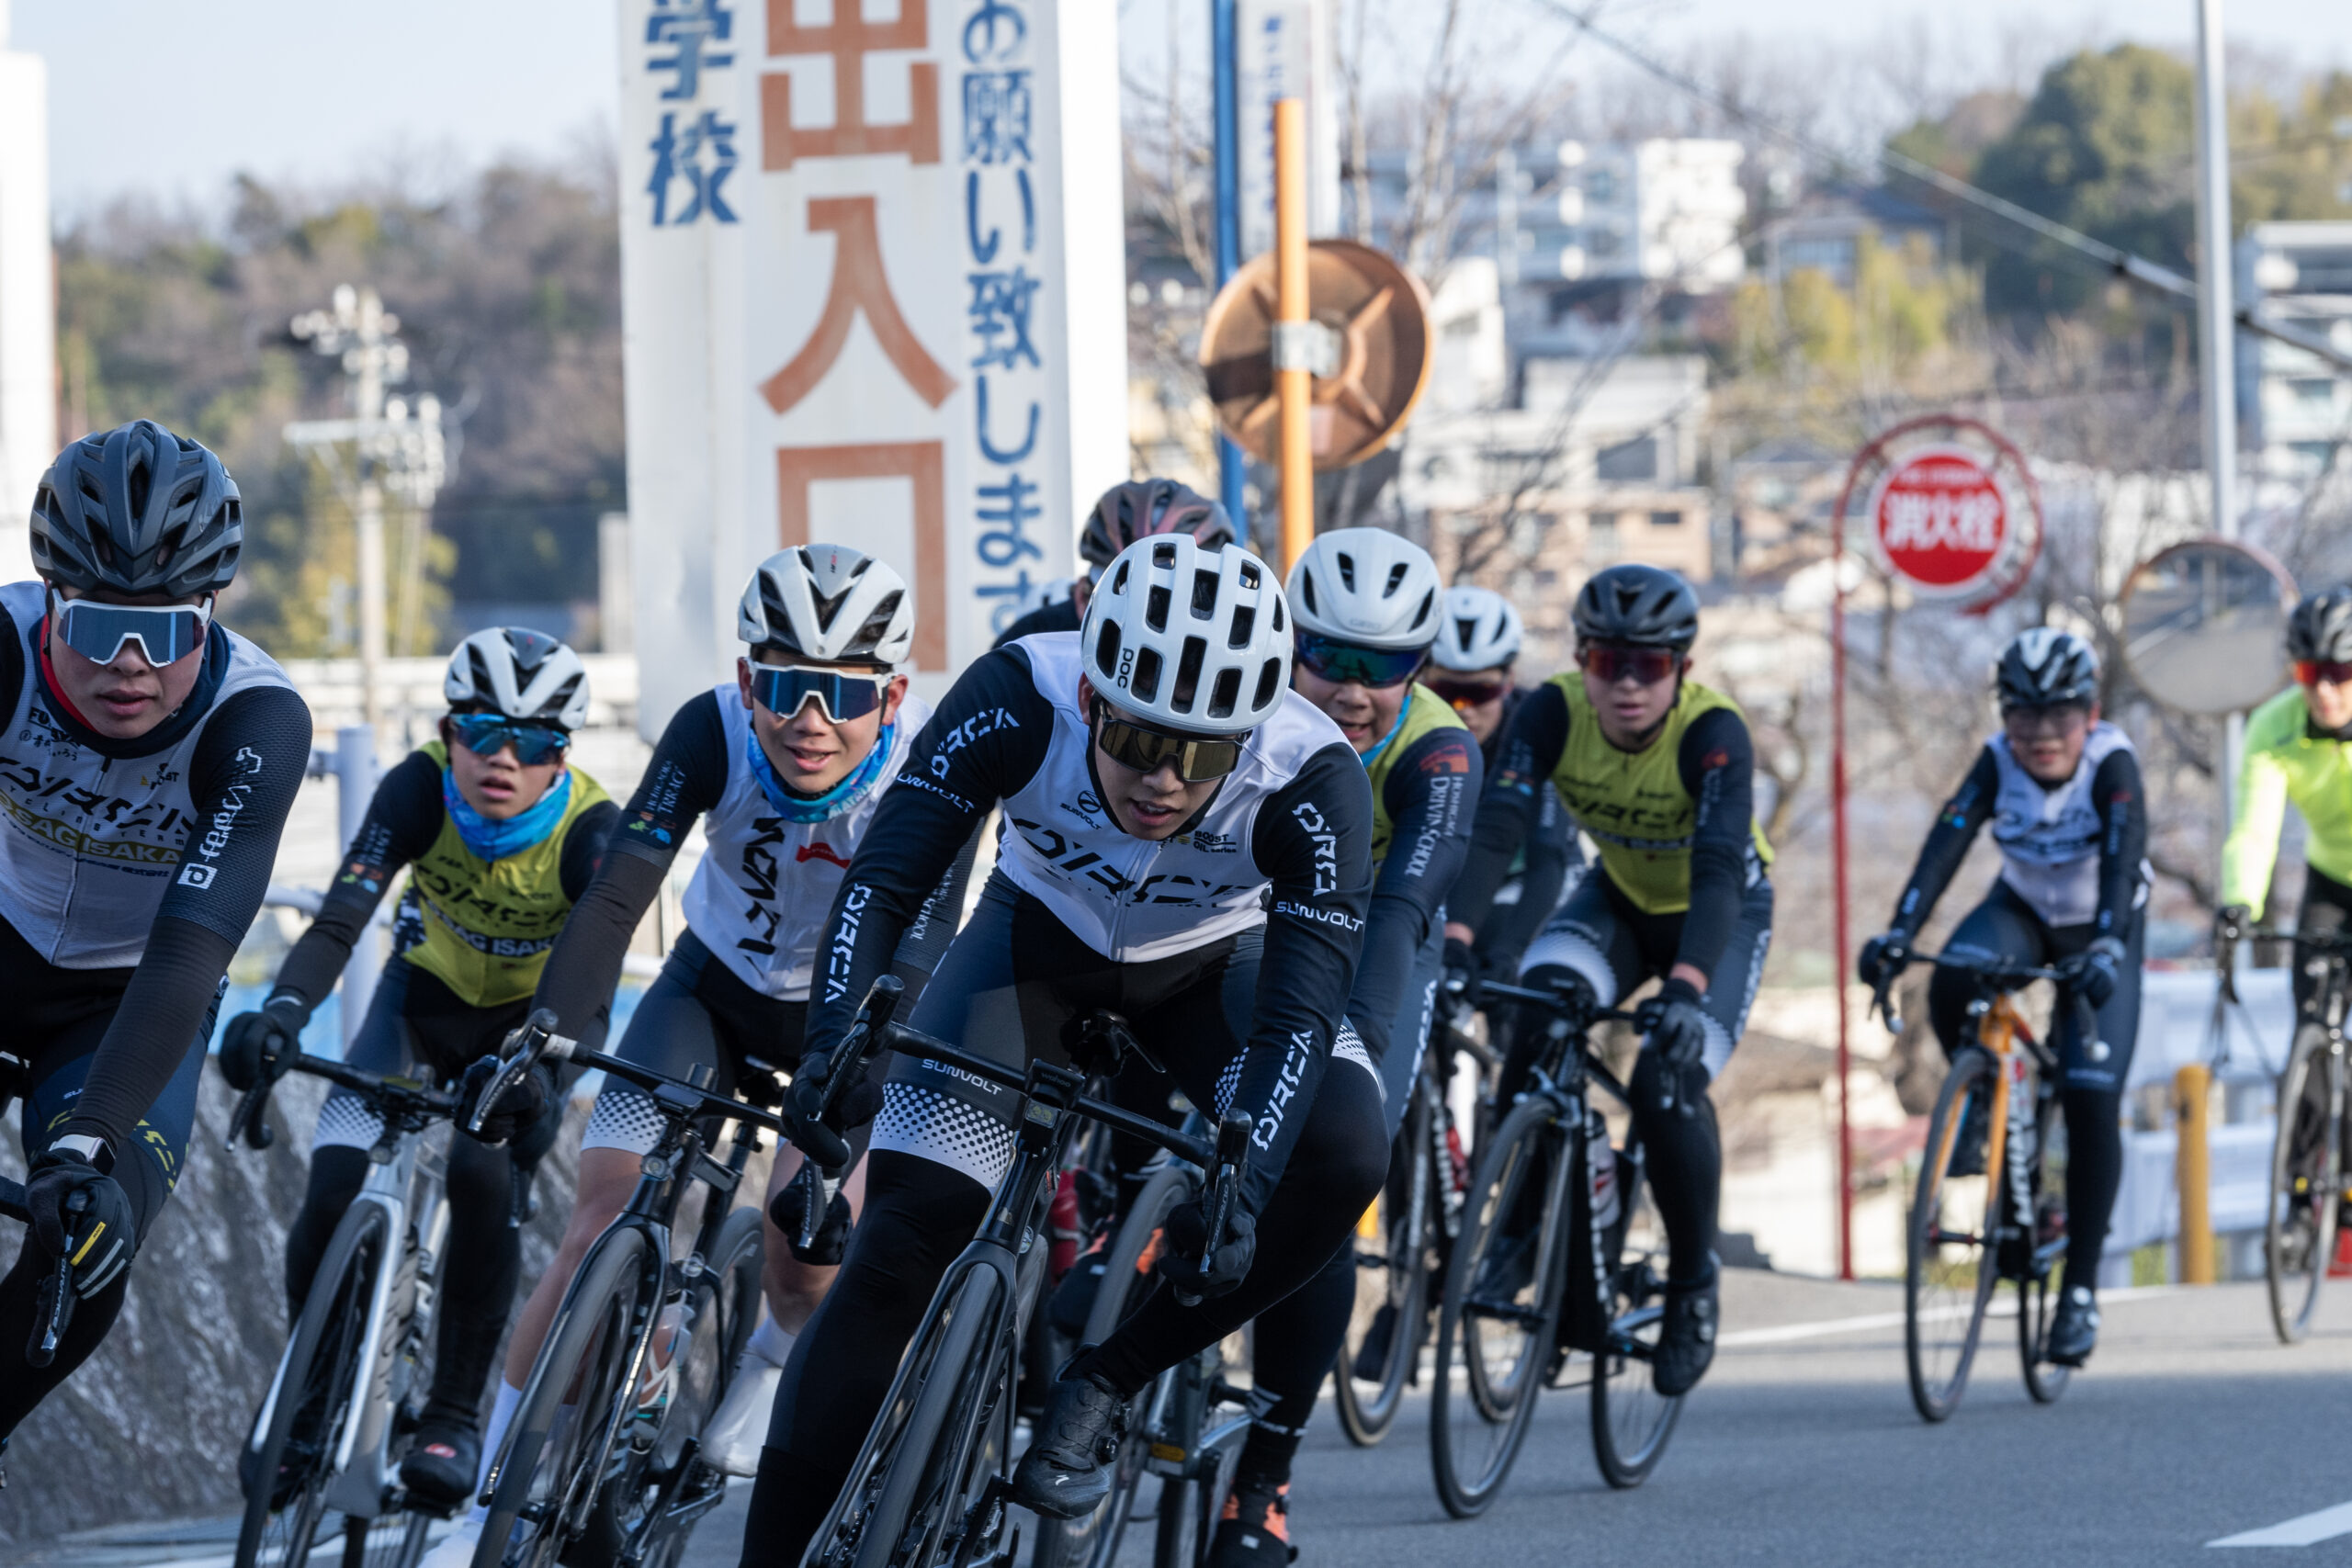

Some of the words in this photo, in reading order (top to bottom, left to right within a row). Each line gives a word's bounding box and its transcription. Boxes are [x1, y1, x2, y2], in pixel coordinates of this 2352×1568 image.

[645, 0, 741, 227] 学校
[757, 0, 960, 671] 出入口
[1059, 802, 1102, 830] SUNVOLT
[1193, 830, 1230, 844] BOOST
[1193, 840, 1210, 853] OIL
[1273, 901, 1364, 932] SUNVOLT
[922, 1058, 1002, 1096] SUNVOLT
